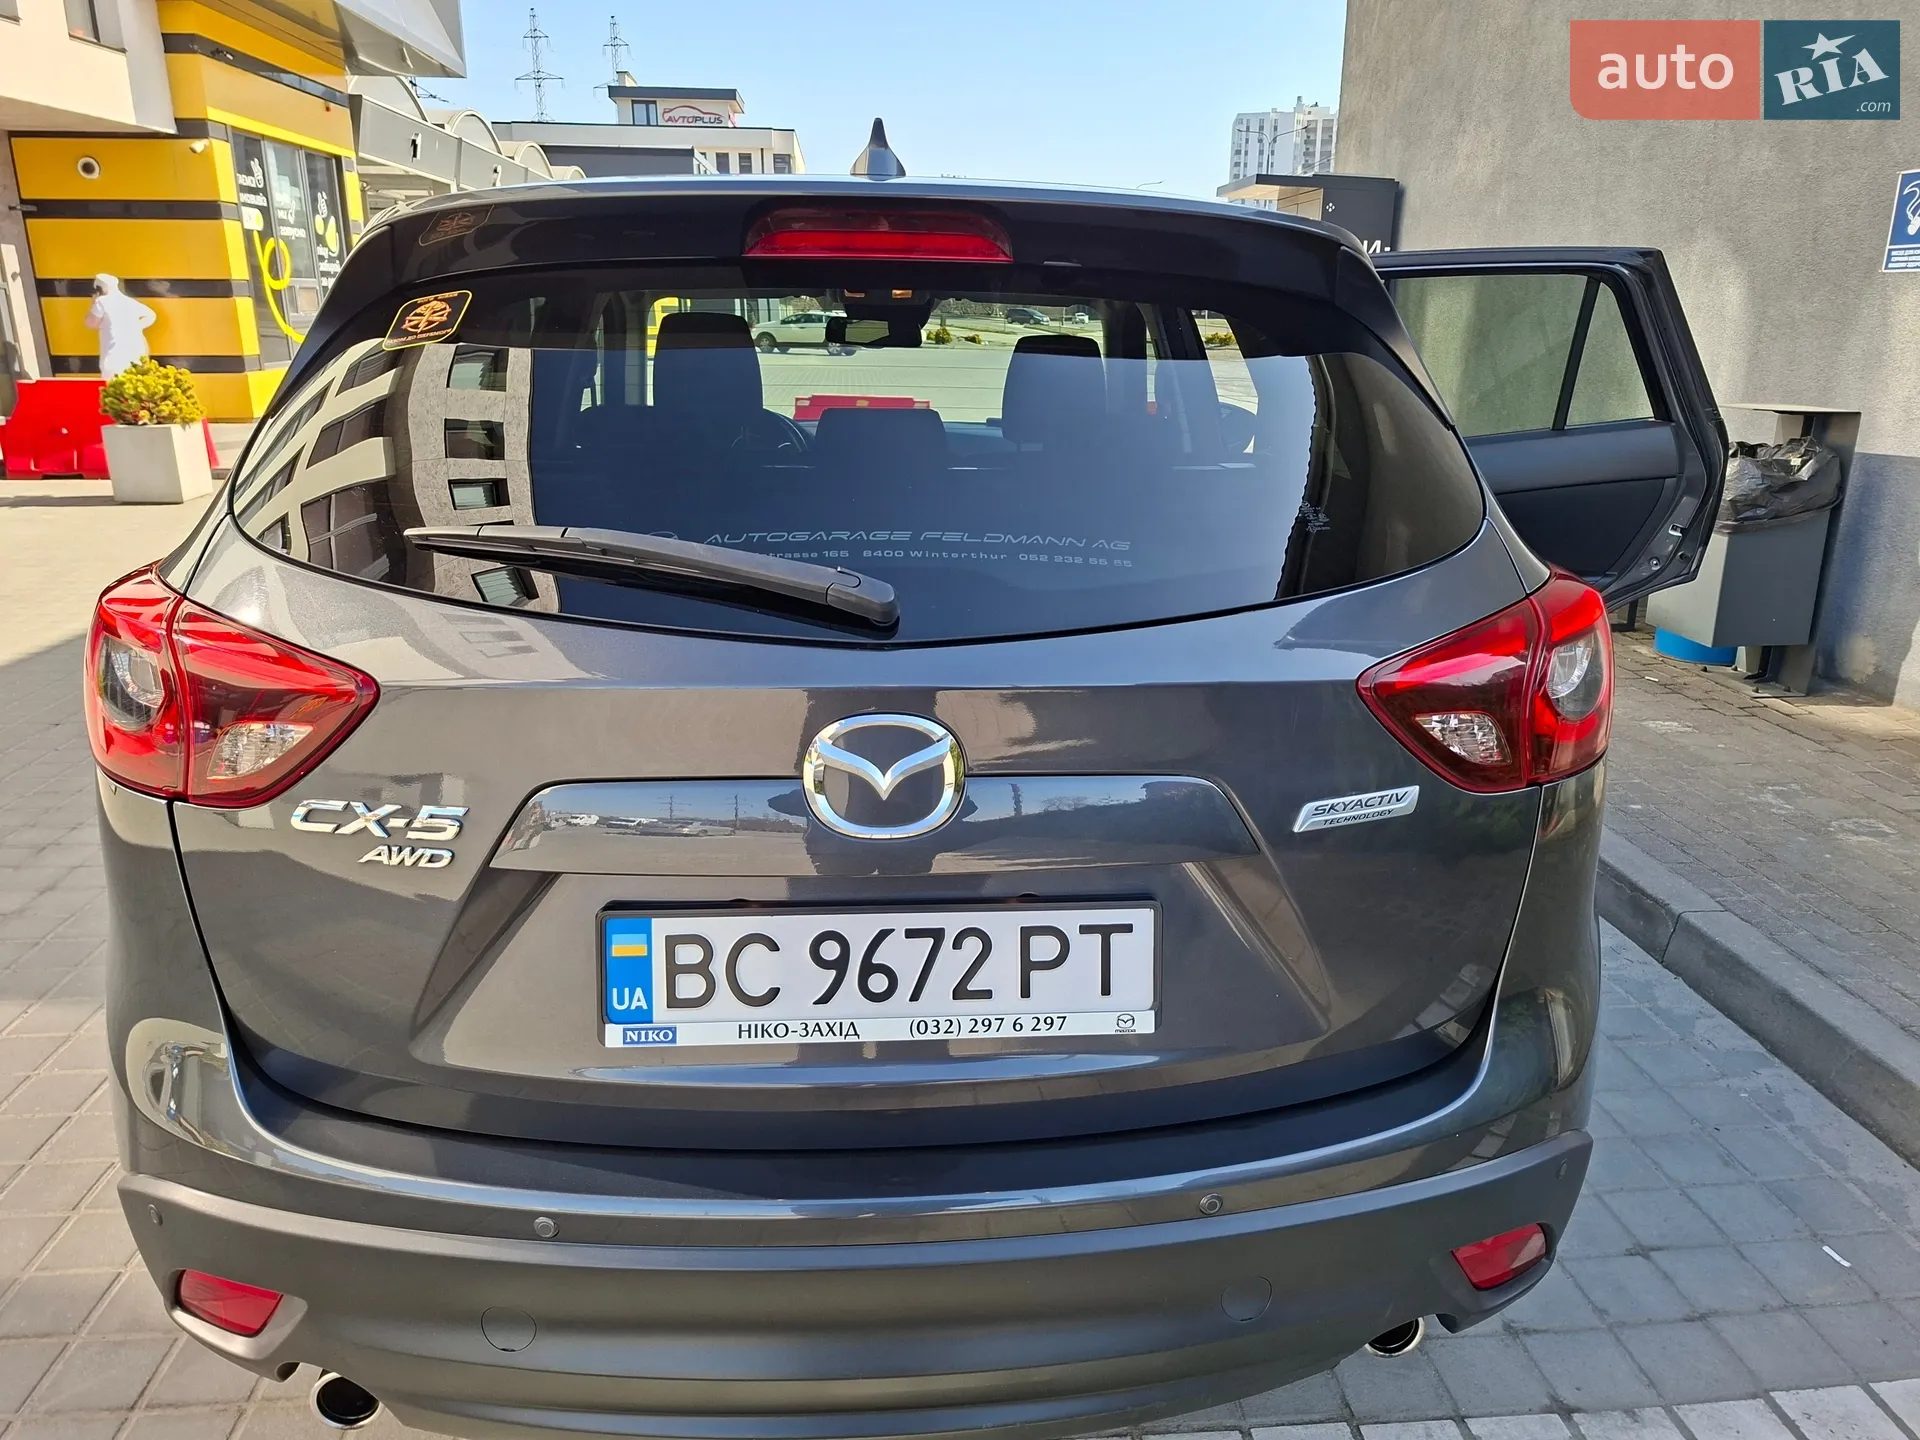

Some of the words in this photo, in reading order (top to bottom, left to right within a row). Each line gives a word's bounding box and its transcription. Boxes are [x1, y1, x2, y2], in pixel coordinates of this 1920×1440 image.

[410, 132, 421, 162] 1
[704, 531, 912, 545] AUTOGARAGE
[920, 531, 1086, 547] FELDMANN
[1092, 540, 1131, 551] AG
[822, 550, 849, 558] 165
[863, 550, 904, 558] 8400
[910, 551, 1008, 560] Winterthur
[1019, 553, 1049, 562] 052
[1311, 791, 1409, 816] SKYACTIV
[290, 799, 470, 841] CX-5
[1323, 809, 1394, 826] TECHNOLOGY
[357, 844, 455, 868] AWD
[664, 932, 780, 1008] BC
[809, 928, 993, 1005] 9672
[1019, 924, 1134, 999] PT
[612, 988, 648, 1010] UA
[625, 1029, 673, 1043] NIKO
[738, 1022, 860, 1040] НІКО-ЗАХІД
[909, 1018, 962, 1038] (032)
[968, 1018, 1005, 1034] 297
[1012, 1017, 1024, 1032] 6
[1030, 1016, 1067, 1032] 297
